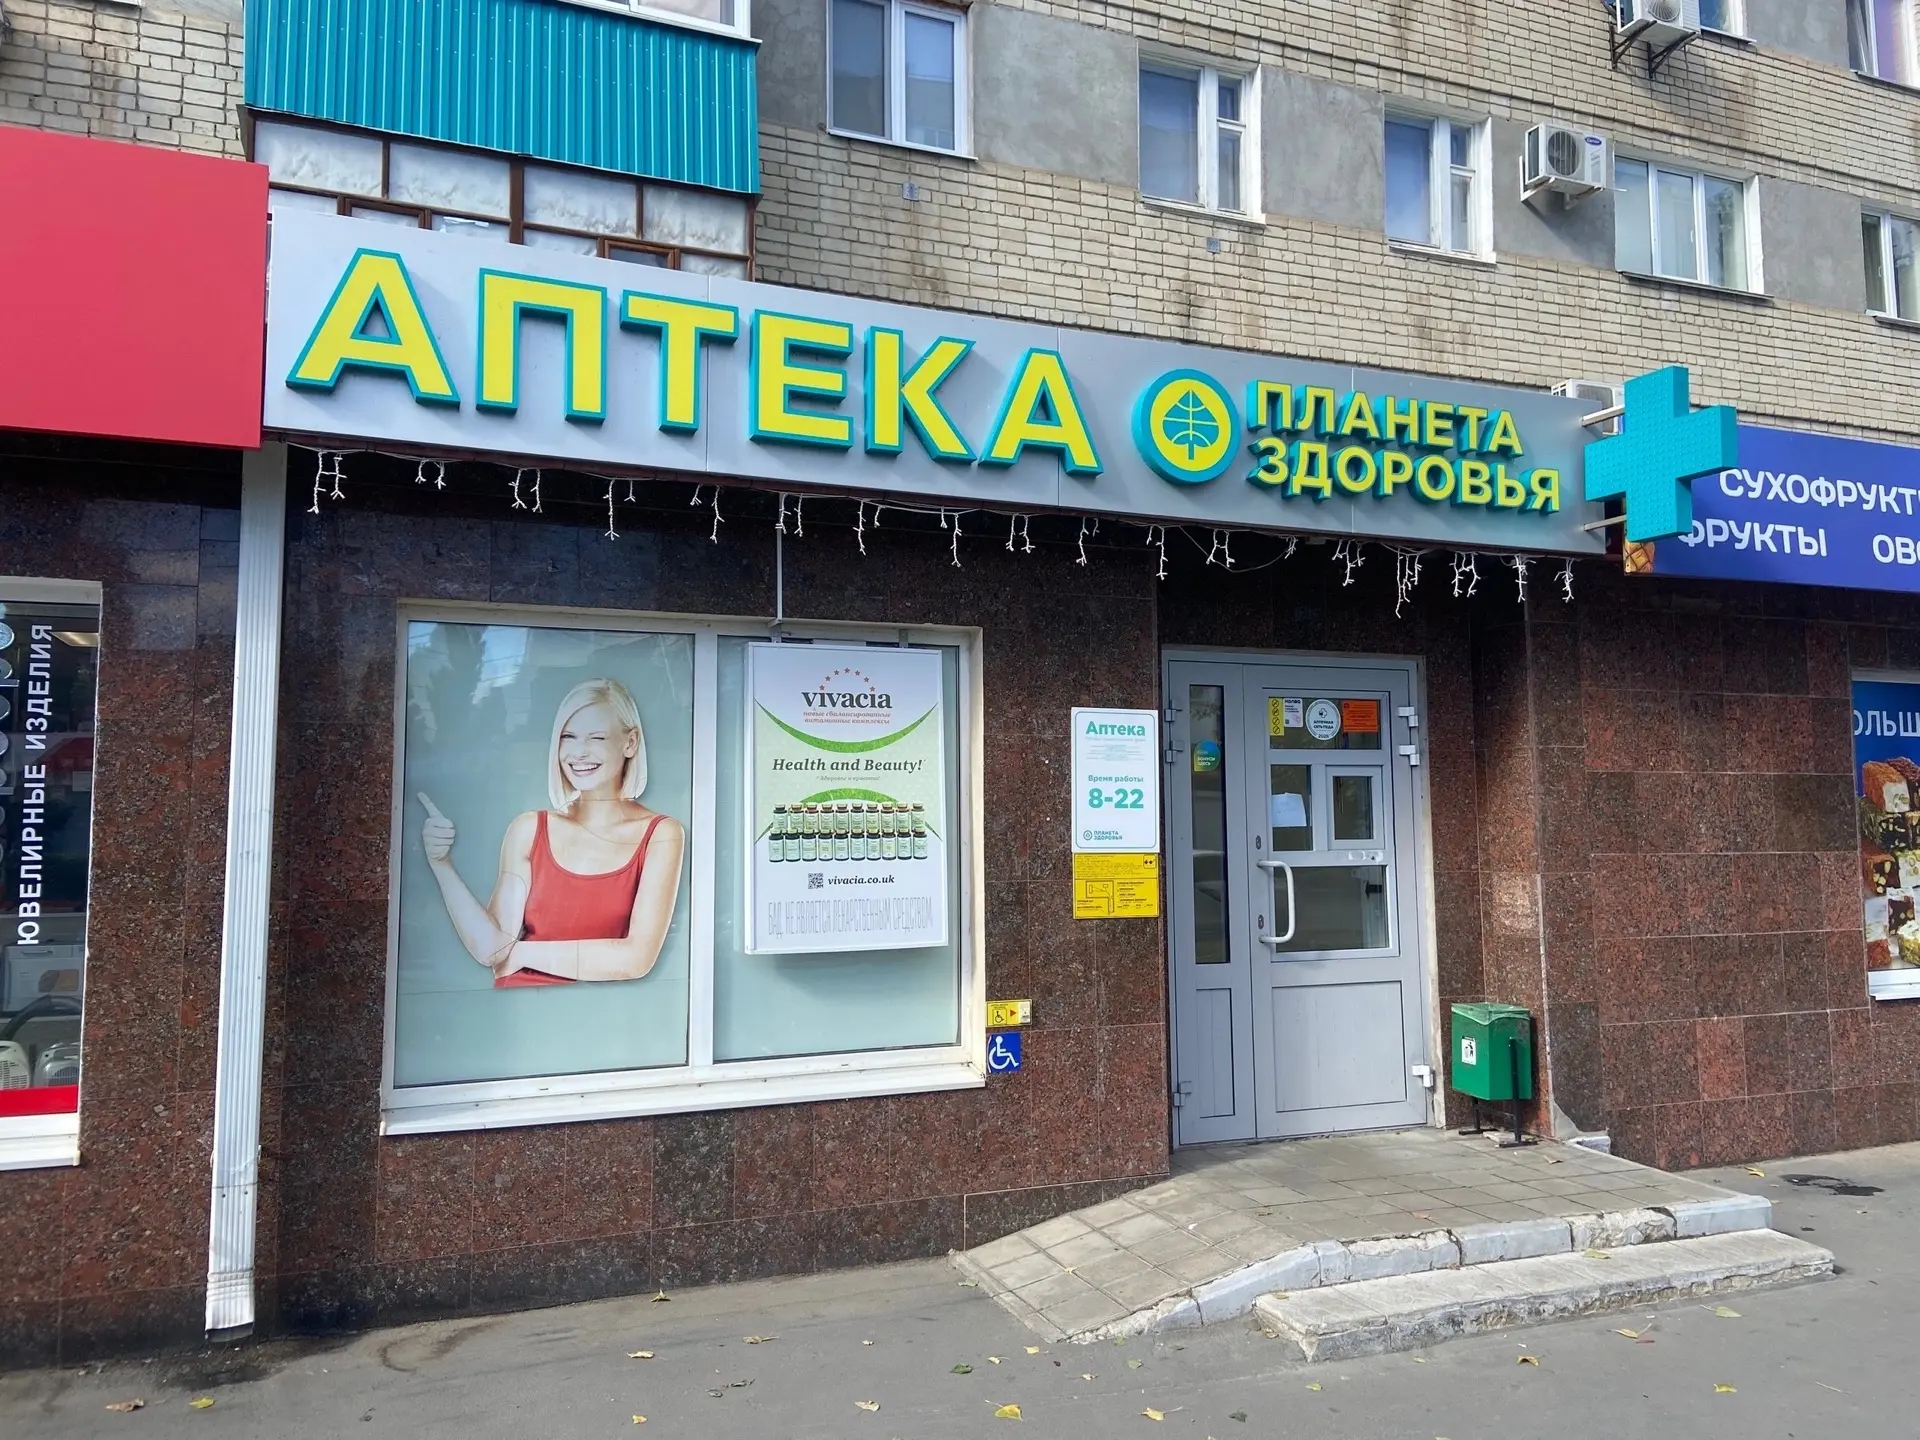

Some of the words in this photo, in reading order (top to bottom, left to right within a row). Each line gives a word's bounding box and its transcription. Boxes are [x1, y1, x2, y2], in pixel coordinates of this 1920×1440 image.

[286, 247, 1103, 478] АПТЕКА
[1247, 380, 1524, 458] ПЛАНЕТА
[1247, 437, 1559, 514] ЗДОРОВЬЯ
[1719, 468, 1920, 515] СУХОФРУКТ
[1872, 534, 1920, 565] ОВ
[25, 624, 53, 750] ИЗДЕЛИЯ
[801, 690, 892, 709] vivacia
[1085, 720, 1146, 736] Аптека
[771, 758, 826, 771] Health
[830, 758, 860, 771] and
[1088, 774, 1113, 783] Время
[1114, 775, 1144, 783] работы
[1088, 787, 1144, 809] 8-22
[17, 764, 46, 945] ЮВЕЛИРНЫЕ
[828, 874, 895, 885] vivacia.co.uk
[786, 901, 795, 935] НЕ
